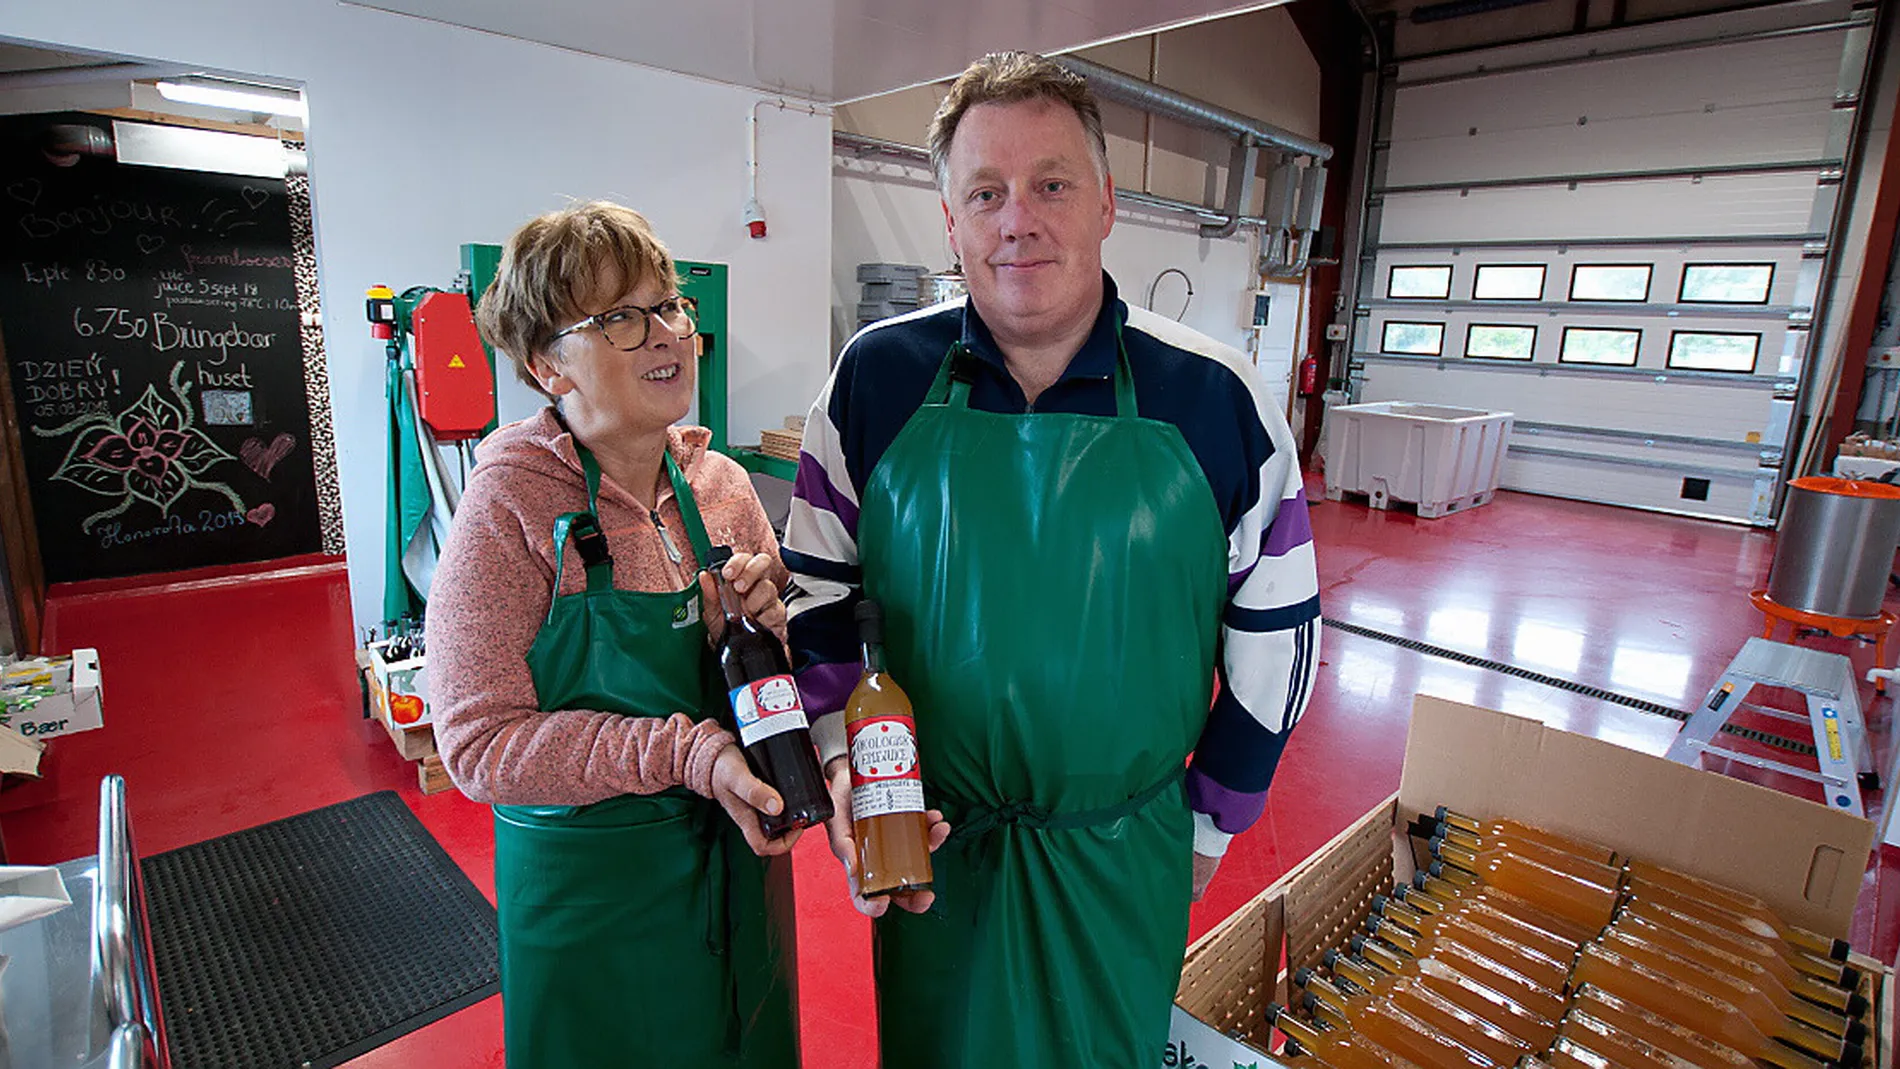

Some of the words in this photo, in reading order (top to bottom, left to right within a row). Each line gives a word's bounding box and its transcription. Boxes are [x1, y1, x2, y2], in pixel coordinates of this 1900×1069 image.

[85, 258, 126, 284] 830
[153, 278, 195, 299] juice
[199, 279, 210, 294] 5
[211, 284, 240, 298] sept
[18, 352, 104, 382] DZIEŃ
[197, 360, 254, 389] huset
[20, 719, 69, 737] Bær
